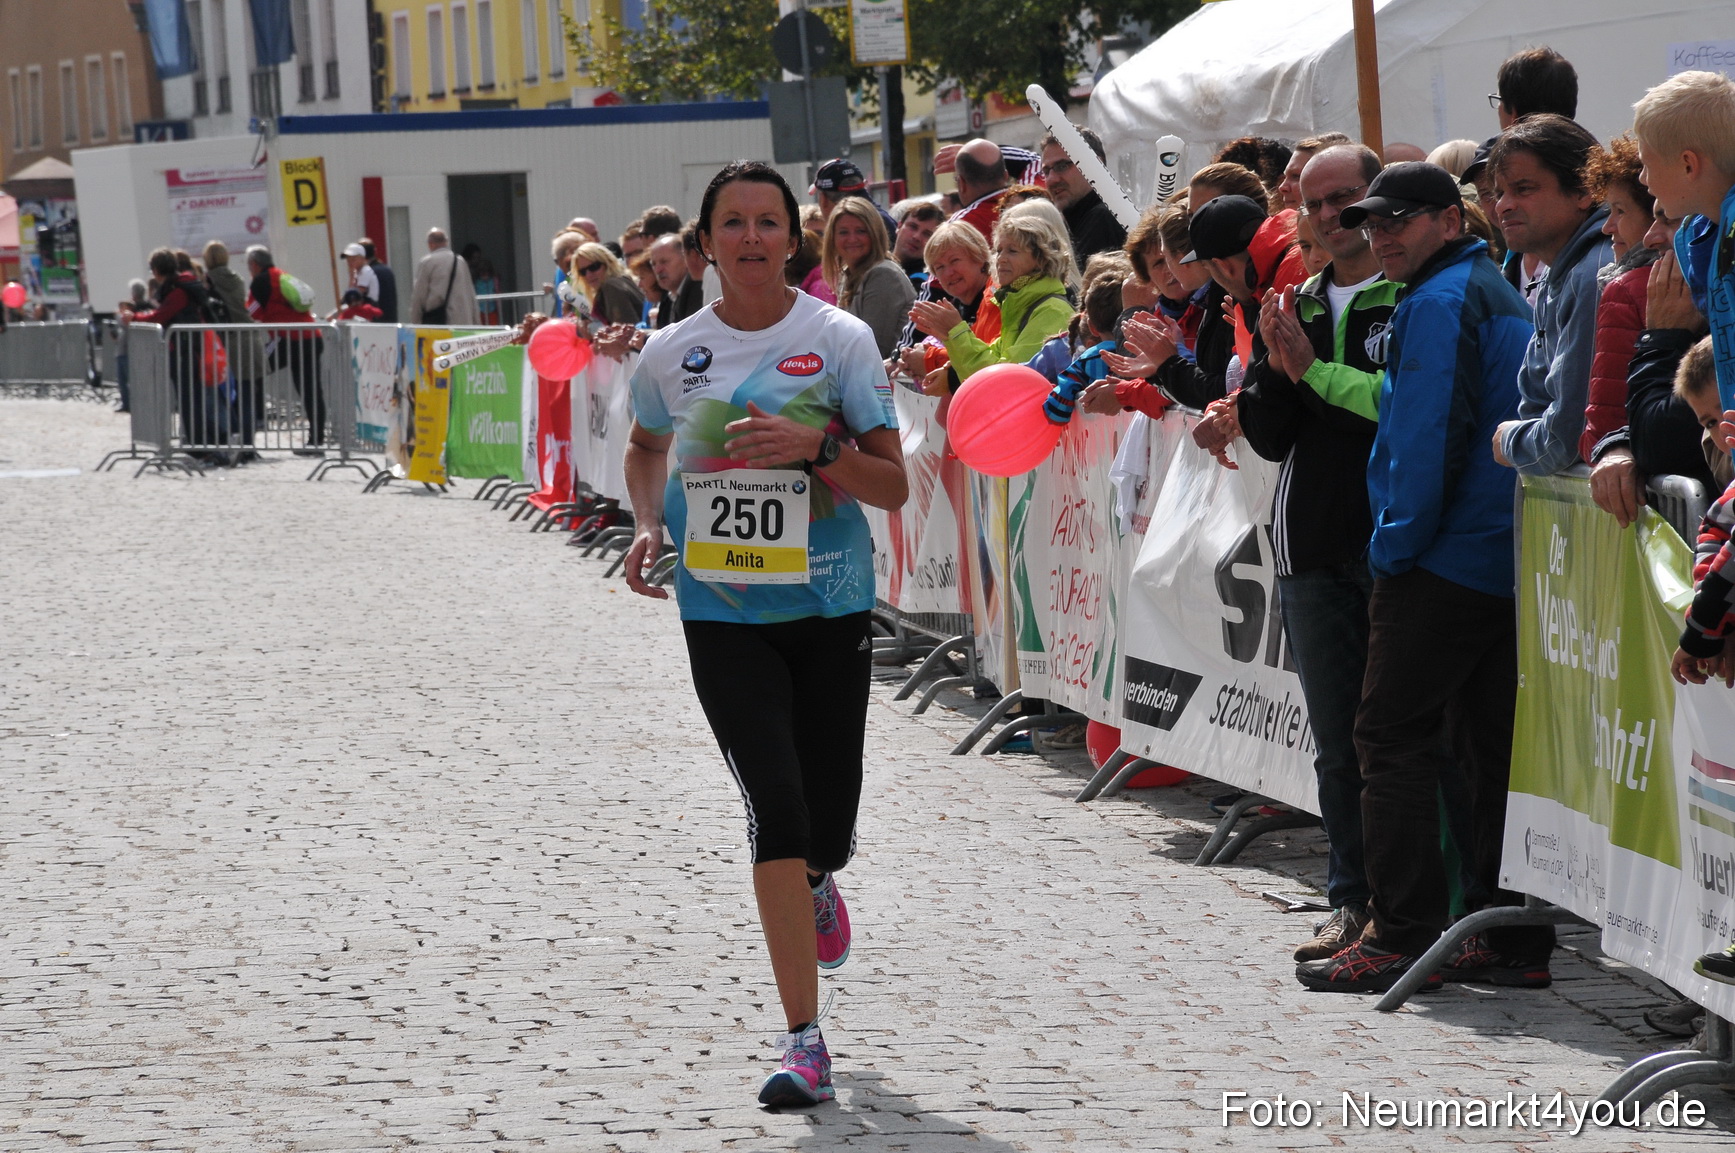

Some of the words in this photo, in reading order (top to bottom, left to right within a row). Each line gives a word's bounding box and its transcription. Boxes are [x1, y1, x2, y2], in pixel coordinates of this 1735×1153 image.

[285, 161, 321, 175] Block
[294, 178, 317, 211] D
[455, 349, 479, 364] BMW
[682, 375, 712, 388] PARTL
[686, 480, 727, 490] PARTL
[729, 480, 788, 493] Neumarkt
[710, 495, 784, 541] 250
[725, 550, 764, 568] Anita
[1550, 524, 1567, 575] Der
[1536, 572, 1578, 669] Neue
[1124, 680, 1178, 713] verbinden
[1209, 679, 1301, 749] stadtwerke
